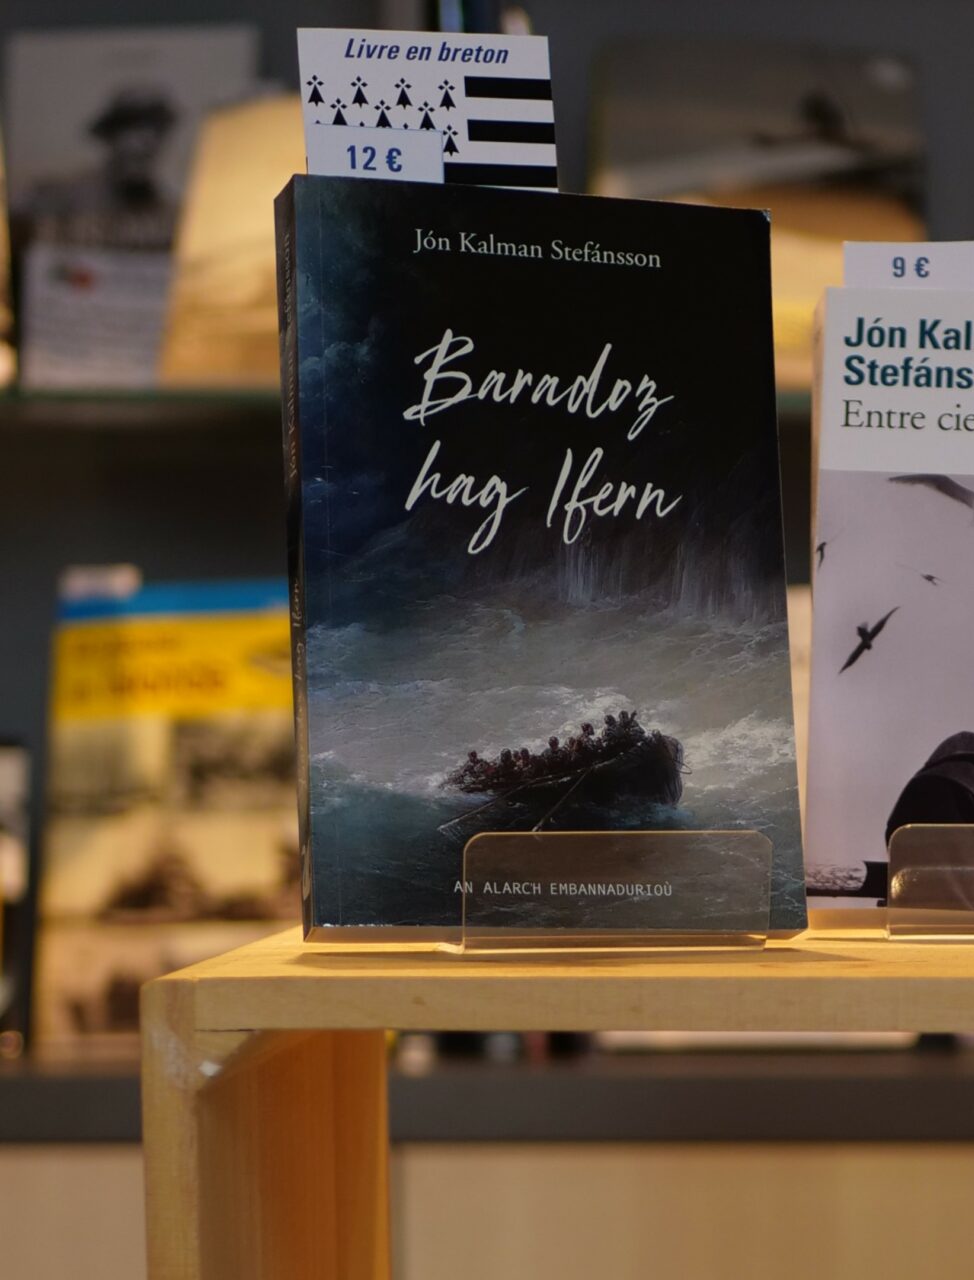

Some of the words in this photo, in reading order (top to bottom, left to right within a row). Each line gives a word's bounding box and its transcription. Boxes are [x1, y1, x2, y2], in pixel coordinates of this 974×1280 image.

[344, 37, 399, 61] Livre
[405, 44, 432, 62] en
[437, 42, 509, 65] breton
[346, 145, 377, 171] 12
[386, 148, 403, 173] €
[413, 228, 451, 254] Jón
[459, 233, 543, 258] Kalman
[550, 238, 661, 268] Stefánsson
[892, 256, 906, 278] 9
[914, 257, 930, 278] €
[843, 317, 907, 349] Jón
[402, 329, 675, 441] Baradoz
[841, 399, 926, 430] Entre
[405, 440, 530, 555] hag
[545, 447, 684, 545] Ifern
[453, 880, 473, 894] AN
[550, 881, 673, 897] EMBANNADURIOÙ
